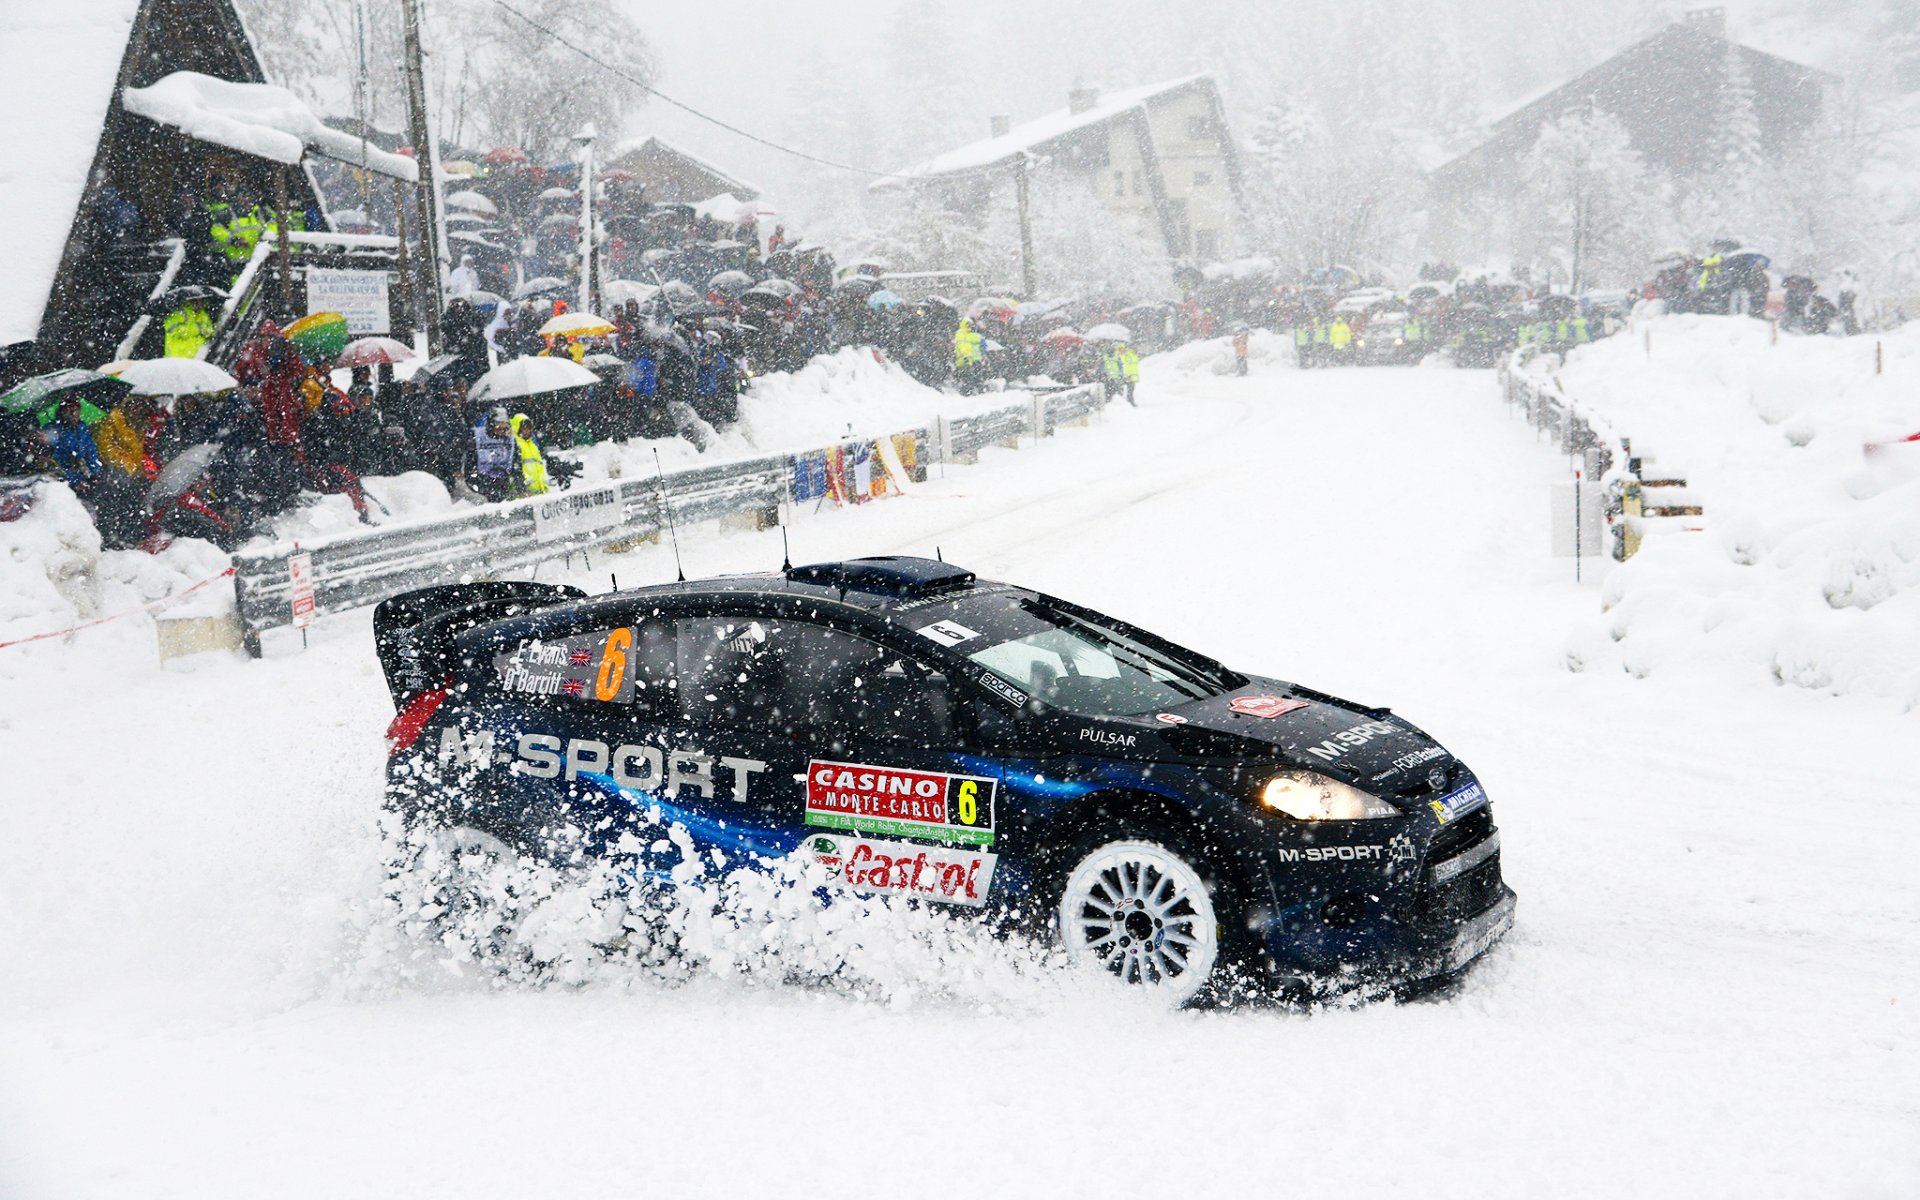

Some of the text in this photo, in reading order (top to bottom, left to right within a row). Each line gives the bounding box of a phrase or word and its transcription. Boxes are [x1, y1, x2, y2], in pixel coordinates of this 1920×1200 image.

[529, 640, 568, 666] Evans
[595, 627, 632, 702] 6
[405, 677, 424, 687] NGK
[982, 673, 1027, 704] sparco
[1079, 728, 1136, 747] PULSAR
[438, 727, 766, 803] M-SPORT
[815, 769, 939, 798] CASINO
[1447, 784, 1481, 809] MICHELIN
[826, 791, 942, 819] MONTE-CARLO
[958, 780, 978, 825] 6
[1367, 805, 1396, 816] PIAA
[854, 818, 875, 831] World
[877, 821, 896, 833] Rally
[898, 822, 950, 841] Championship
[1279, 845, 1384, 863] M-SPORT
[845, 844, 982, 899] Castrol
